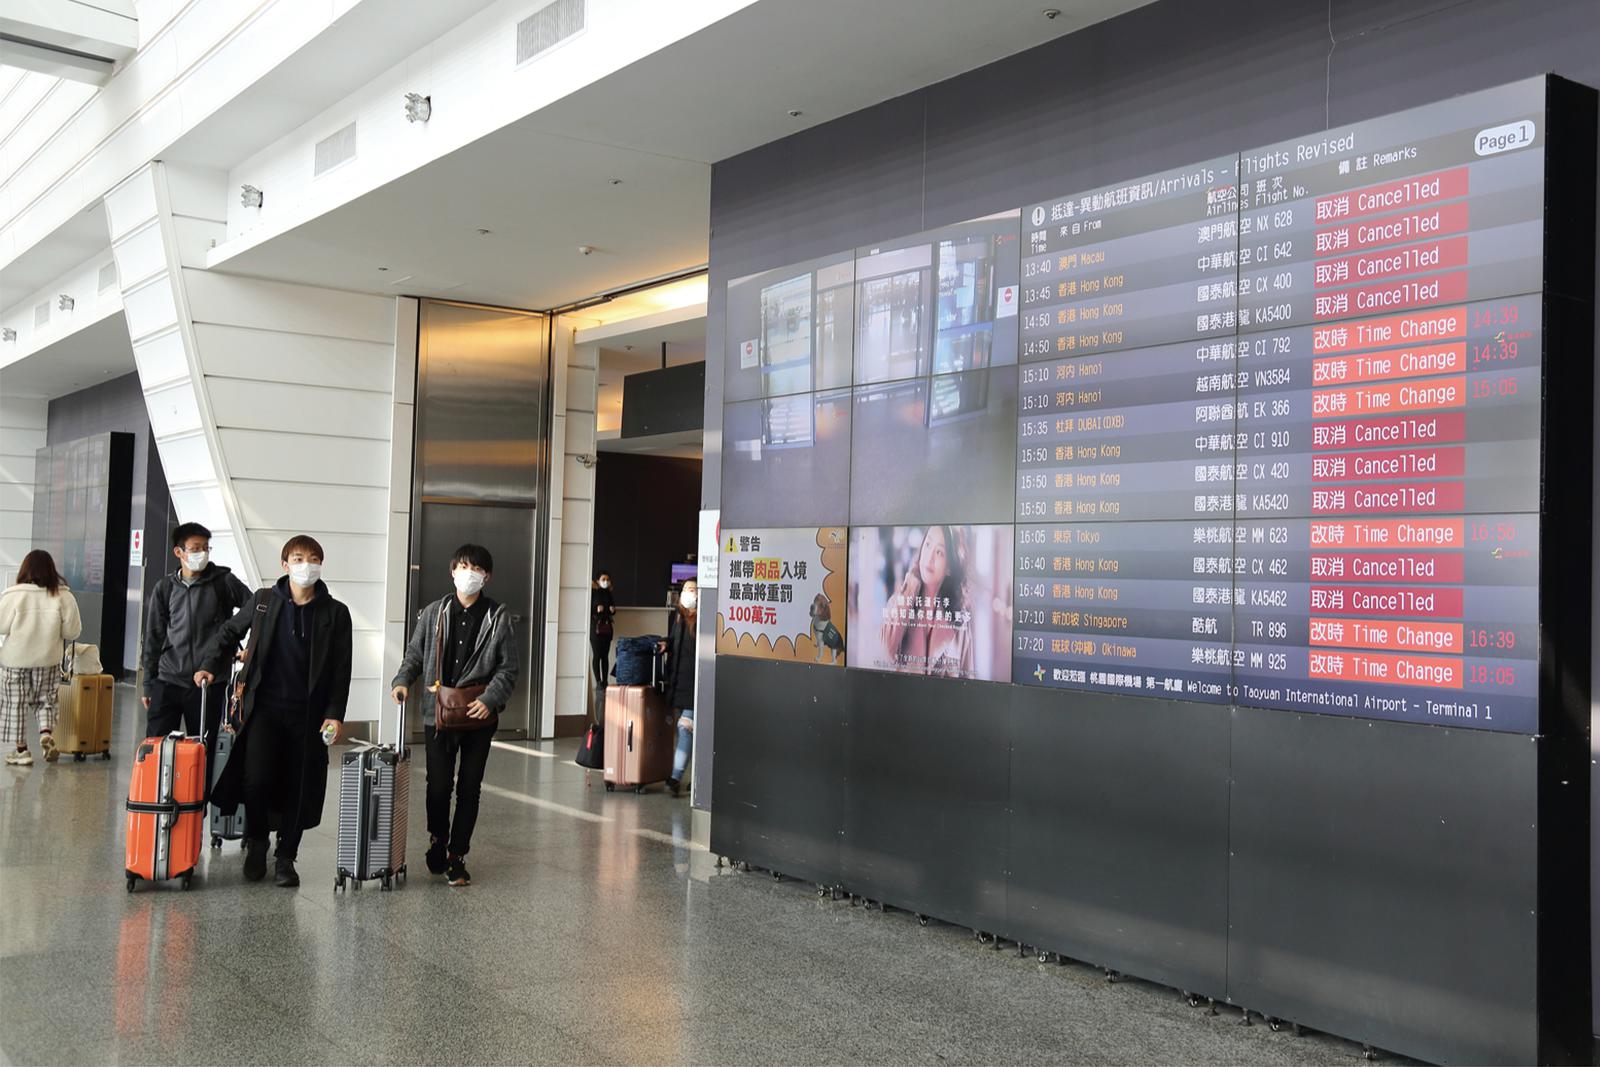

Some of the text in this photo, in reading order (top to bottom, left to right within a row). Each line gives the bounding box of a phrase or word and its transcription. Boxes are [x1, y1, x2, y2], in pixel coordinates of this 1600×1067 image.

[1297, 132, 1354, 162] Revised
[1373, 147, 1417, 166] Remarks
[1207, 186, 1309, 216] Airlines Flight No.
[1025, 260, 1051, 277] 13:40
[1081, 251, 1104, 264] Macau
[1257, 215, 1268, 232] NX
[1274, 210, 1293, 228] 628
[1317, 197, 1349, 220] 取消
[1359, 178, 1439, 211] Cancelled
[1084, 219, 1101, 231] From
[1025, 286, 1050, 303] 13:45
[1081, 280, 1100, 292] Hong
[1104, 275, 1123, 288] Kong
[1257, 246, 1268, 262] CI
[1274, 241, 1292, 259] 642
[1317, 229, 1349, 252] 取消
[1358, 212, 1439, 244] Cancelled
[1024, 313, 1050, 329] 14:50
[1080, 307, 1099, 320] Hong
[1103, 304, 1123, 316] Kong
[1257, 276, 1268, 292] CX
[1274, 273, 1292, 289] 400
[1316, 261, 1348, 283] 取消
[1358, 246, 1439, 276] Cancelled
[1024, 340, 1049, 356] 14:50
[1080, 335, 1098, 347] Hong
[1103, 331, 1123, 344] Kong
[1256, 304, 1291, 323] KA5400
[1316, 294, 1348, 316] 取消
[1357, 280, 1438, 309] Cancelled
[1023, 368, 1049, 383] 15:10
[1079, 361, 1102, 376] Hanoi
[1255, 340, 1266, 356] CI
[1273, 337, 1290, 353] 792
[1314, 328, 1347, 349] 改時
[1357, 325, 1392, 343] Time
[1401, 317, 1456, 338] Change
[1023, 394, 1048, 410] 15:10
[1079, 388, 1101, 403] Hanoi
[1255, 368, 1290, 386] VN3584
[1314, 360, 1347, 381] 改時
[1356, 358, 1391, 376] Time
[1400, 352, 1456, 374] Change
[1473, 342, 1518, 363] 14:39
[1023, 421, 1048, 436] 15:35
[1254, 401, 1266, 418] EK
[1272, 400, 1289, 416] 366
[1314, 393, 1347, 413] 改時
[1356, 391, 1391, 409] Time
[1400, 386, 1456, 408] Change
[1022, 448, 1048, 462] 15:50
[1078, 446, 1096, 459] Hong
[1101, 444, 1121, 457] Kong
[1254, 433, 1265, 448] CI
[1272, 431, 1289, 447] 910
[1314, 425, 1346, 445] 取消
[1356, 419, 1436, 442] Cancelled
[1021, 475, 1047, 489] 15:50
[1077, 473, 1096, 486] Hong
[1101, 473, 1120, 485] Kong
[1254, 464, 1265, 479] CX
[1271, 462, 1289, 479] 420
[1313, 458, 1346, 477] 取消
[1355, 453, 1435, 474] Cancelled
[1021, 502, 1046, 515] 15:50
[1077, 501, 1095, 514] Hong
[1100, 500, 1120, 513] Kong
[1253, 494, 1288, 510] KA5420
[1313, 490, 1345, 510] 取消
[1354, 488, 1435, 508] Cancelled
[740, 535, 760, 552] 警告
[1020, 530, 1045, 544] 16:05
[1077, 531, 1100, 544] Tokyo
[1252, 527, 1264, 543] MM
[1270, 527, 1287, 543] 623
[1312, 525, 1344, 544] 改時
[1354, 525, 1388, 543] Time
[1398, 525, 1453, 544] Change
[730, 560, 807, 580] 攜帶肉品入境
[1019, 557, 1045, 570] 16:40
[1076, 559, 1094, 571] Hong
[1099, 559, 1118, 573] Kong
[1252, 559, 1263, 575] CX
[1269, 559, 1287, 575] 462
[1312, 557, 1344, 577] 取消
[1353, 558, 1434, 577] Cancelled
[729, 582, 792, 603] 最高將重罰
[1019, 584, 1044, 597] 16:40
[1075, 585, 1093, 599] Hong
[1098, 586, 1118, 600] Kong
[1251, 590, 1287, 606] KA5462
[1312, 590, 1344, 609] 取消
[1353, 592, 1434, 611] Cancelled
[729, 605, 776, 625] 100萬元
[1018, 610, 1044, 624] 17:10
[1084, 613, 1127, 629] Singapore
[1252, 621, 1263, 637] TR
[1269, 621, 1286, 638] 896
[1311, 622, 1344, 642] 改時
[1353, 624, 1388, 644] Time
[1397, 626, 1453, 647] Change
[1470, 630, 1515, 649] 16:39
[1018, 637, 1044, 651] 17:20
[1102, 643, 1137, 658] Okinawa
[1250, 653, 1263, 669] MM
[1269, 654, 1286, 670] 925
[1311, 654, 1344, 675] 改時
[1353, 657, 1388, 677] Time
[1397, 660, 1452, 683] Change
[1470, 666, 1514, 684] 18:05
[1187, 681, 1222, 696] Welcome
[1227, 684, 1239, 696] to
[1244, 686, 1280, 701] Taoyuan
[1286, 689, 1358, 708] International
[1364, 697, 1407, 712] Airport
[1426, 702, 1478, 718] Terminal
[1486, 706, 1492, 720] 1
